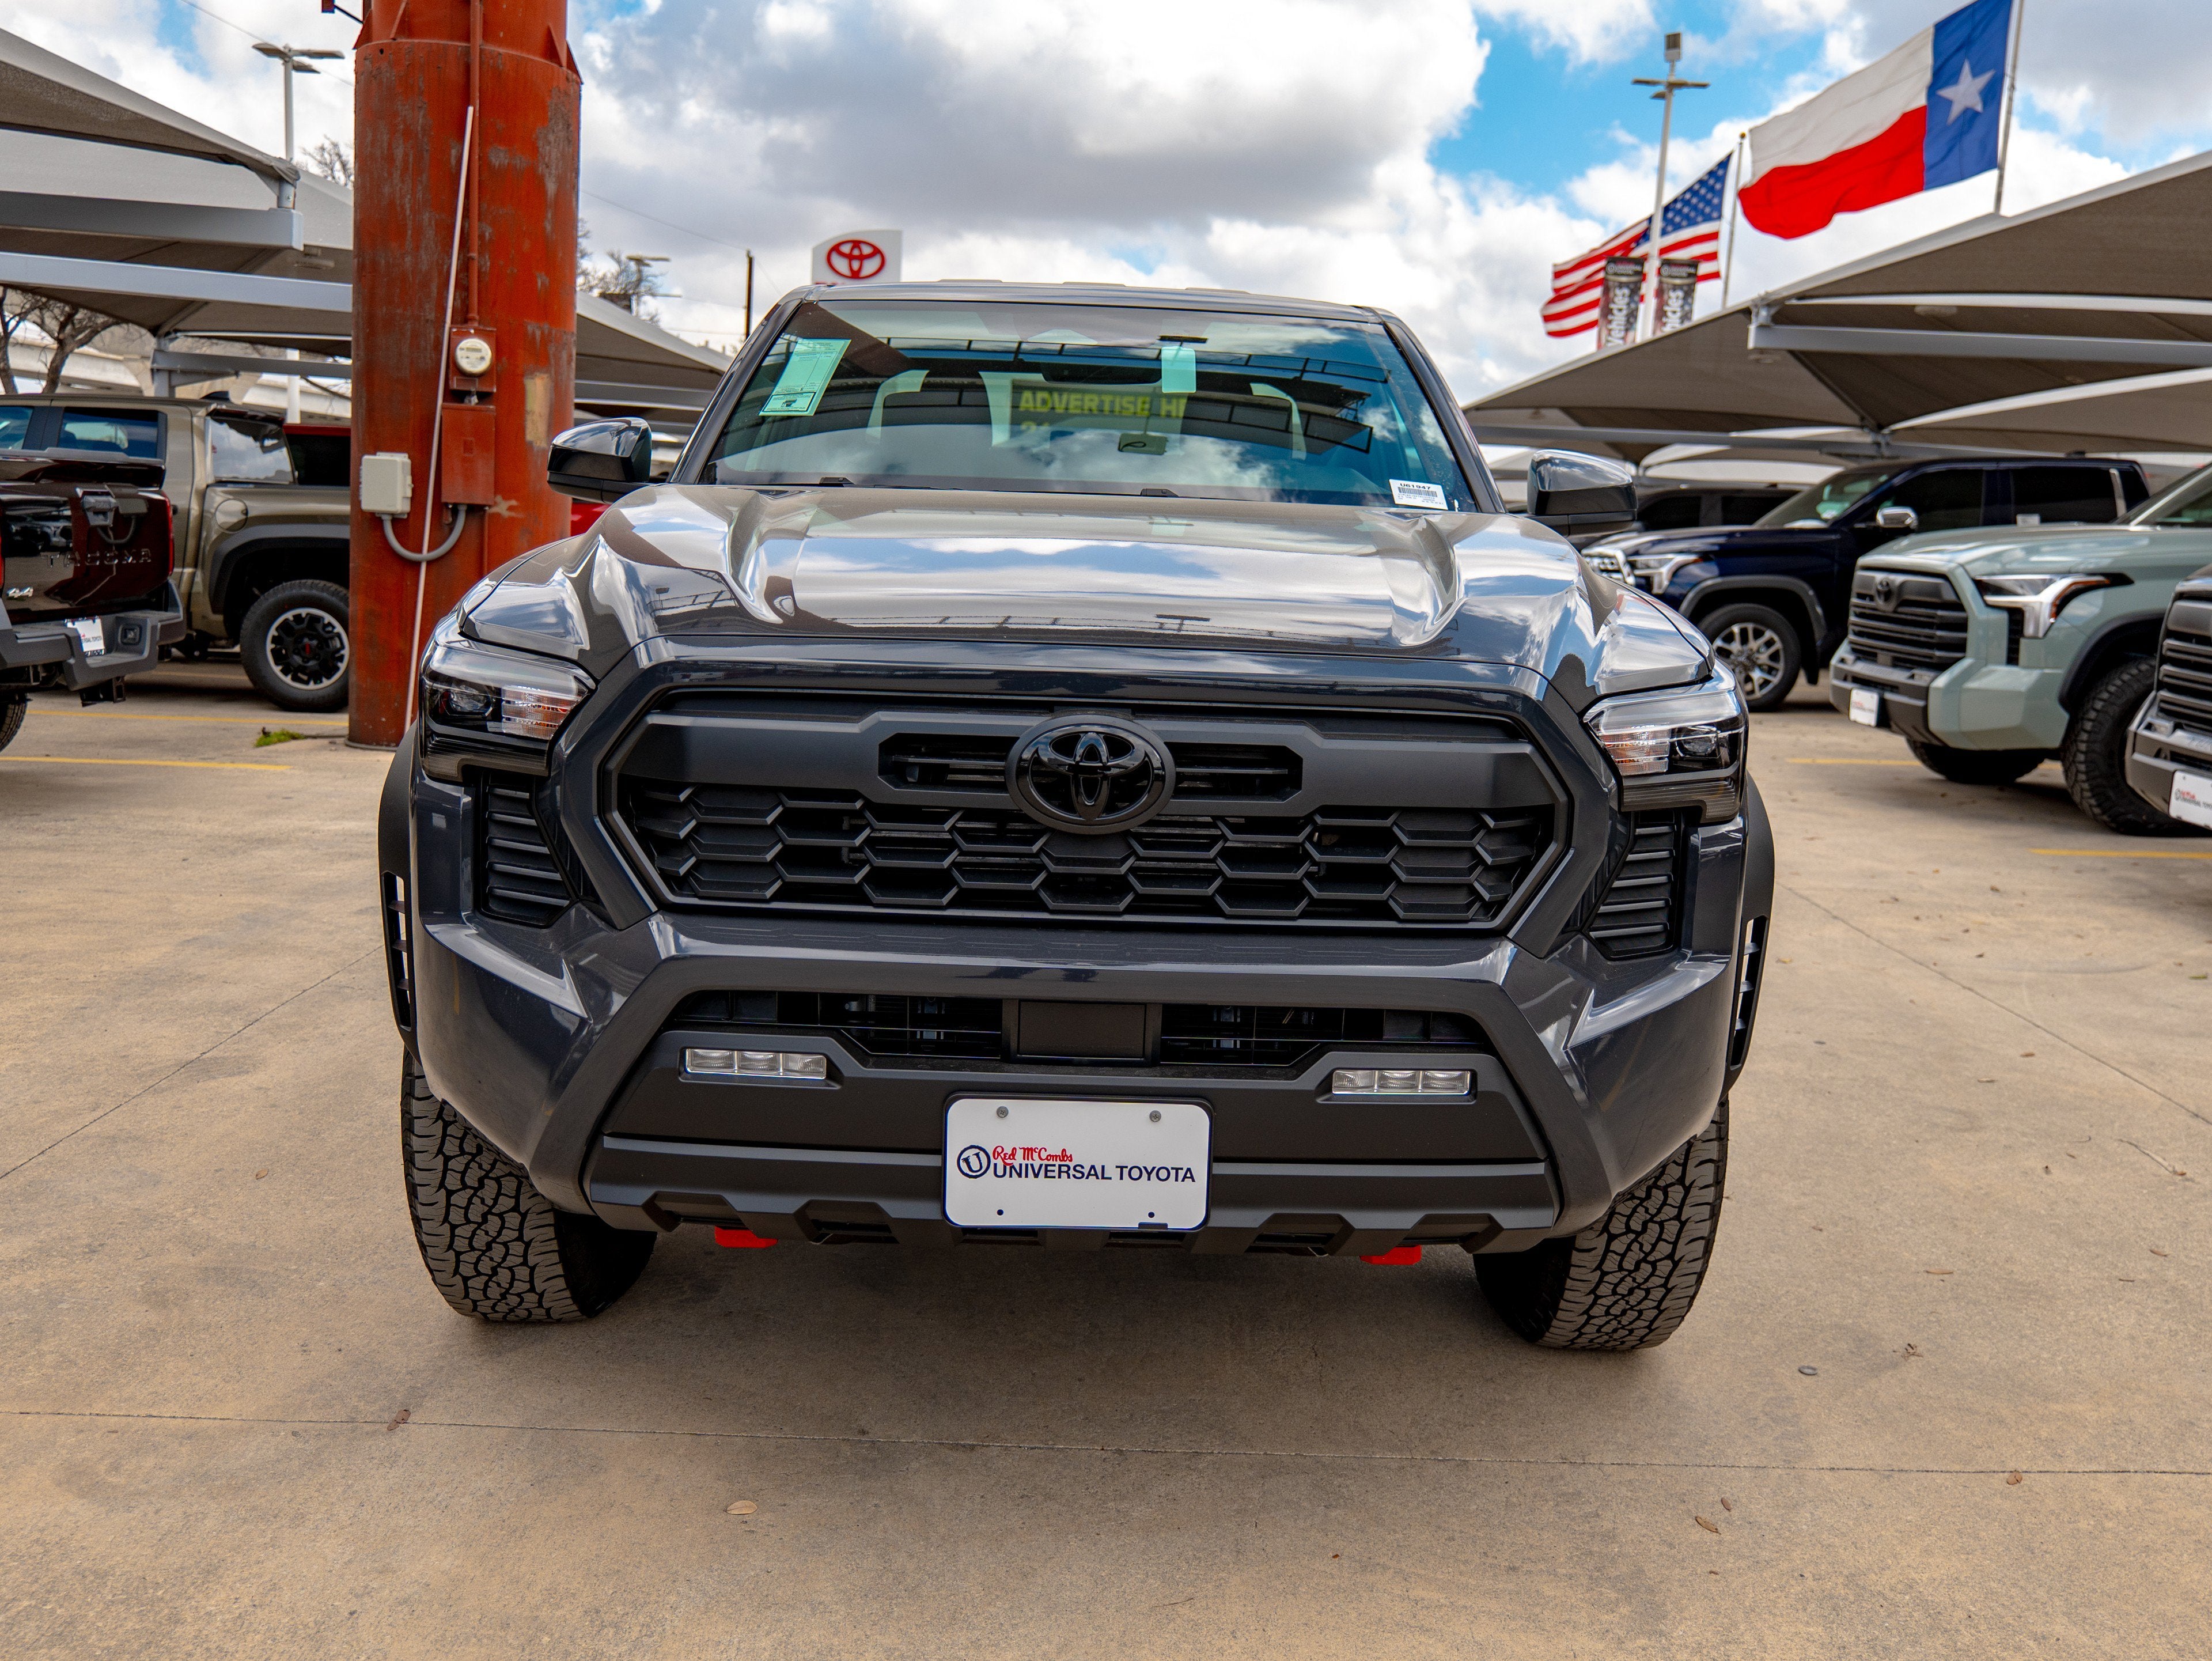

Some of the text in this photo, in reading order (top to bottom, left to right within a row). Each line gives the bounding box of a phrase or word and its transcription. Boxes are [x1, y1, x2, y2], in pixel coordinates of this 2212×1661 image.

[1019, 390, 1151, 417] ADVERTISE
[40, 548, 151, 567] TACOMA
[993, 1145, 1073, 1166] Red McCombs
[993, 1163, 1196, 1183] UNIVERSAL TOYOTA
